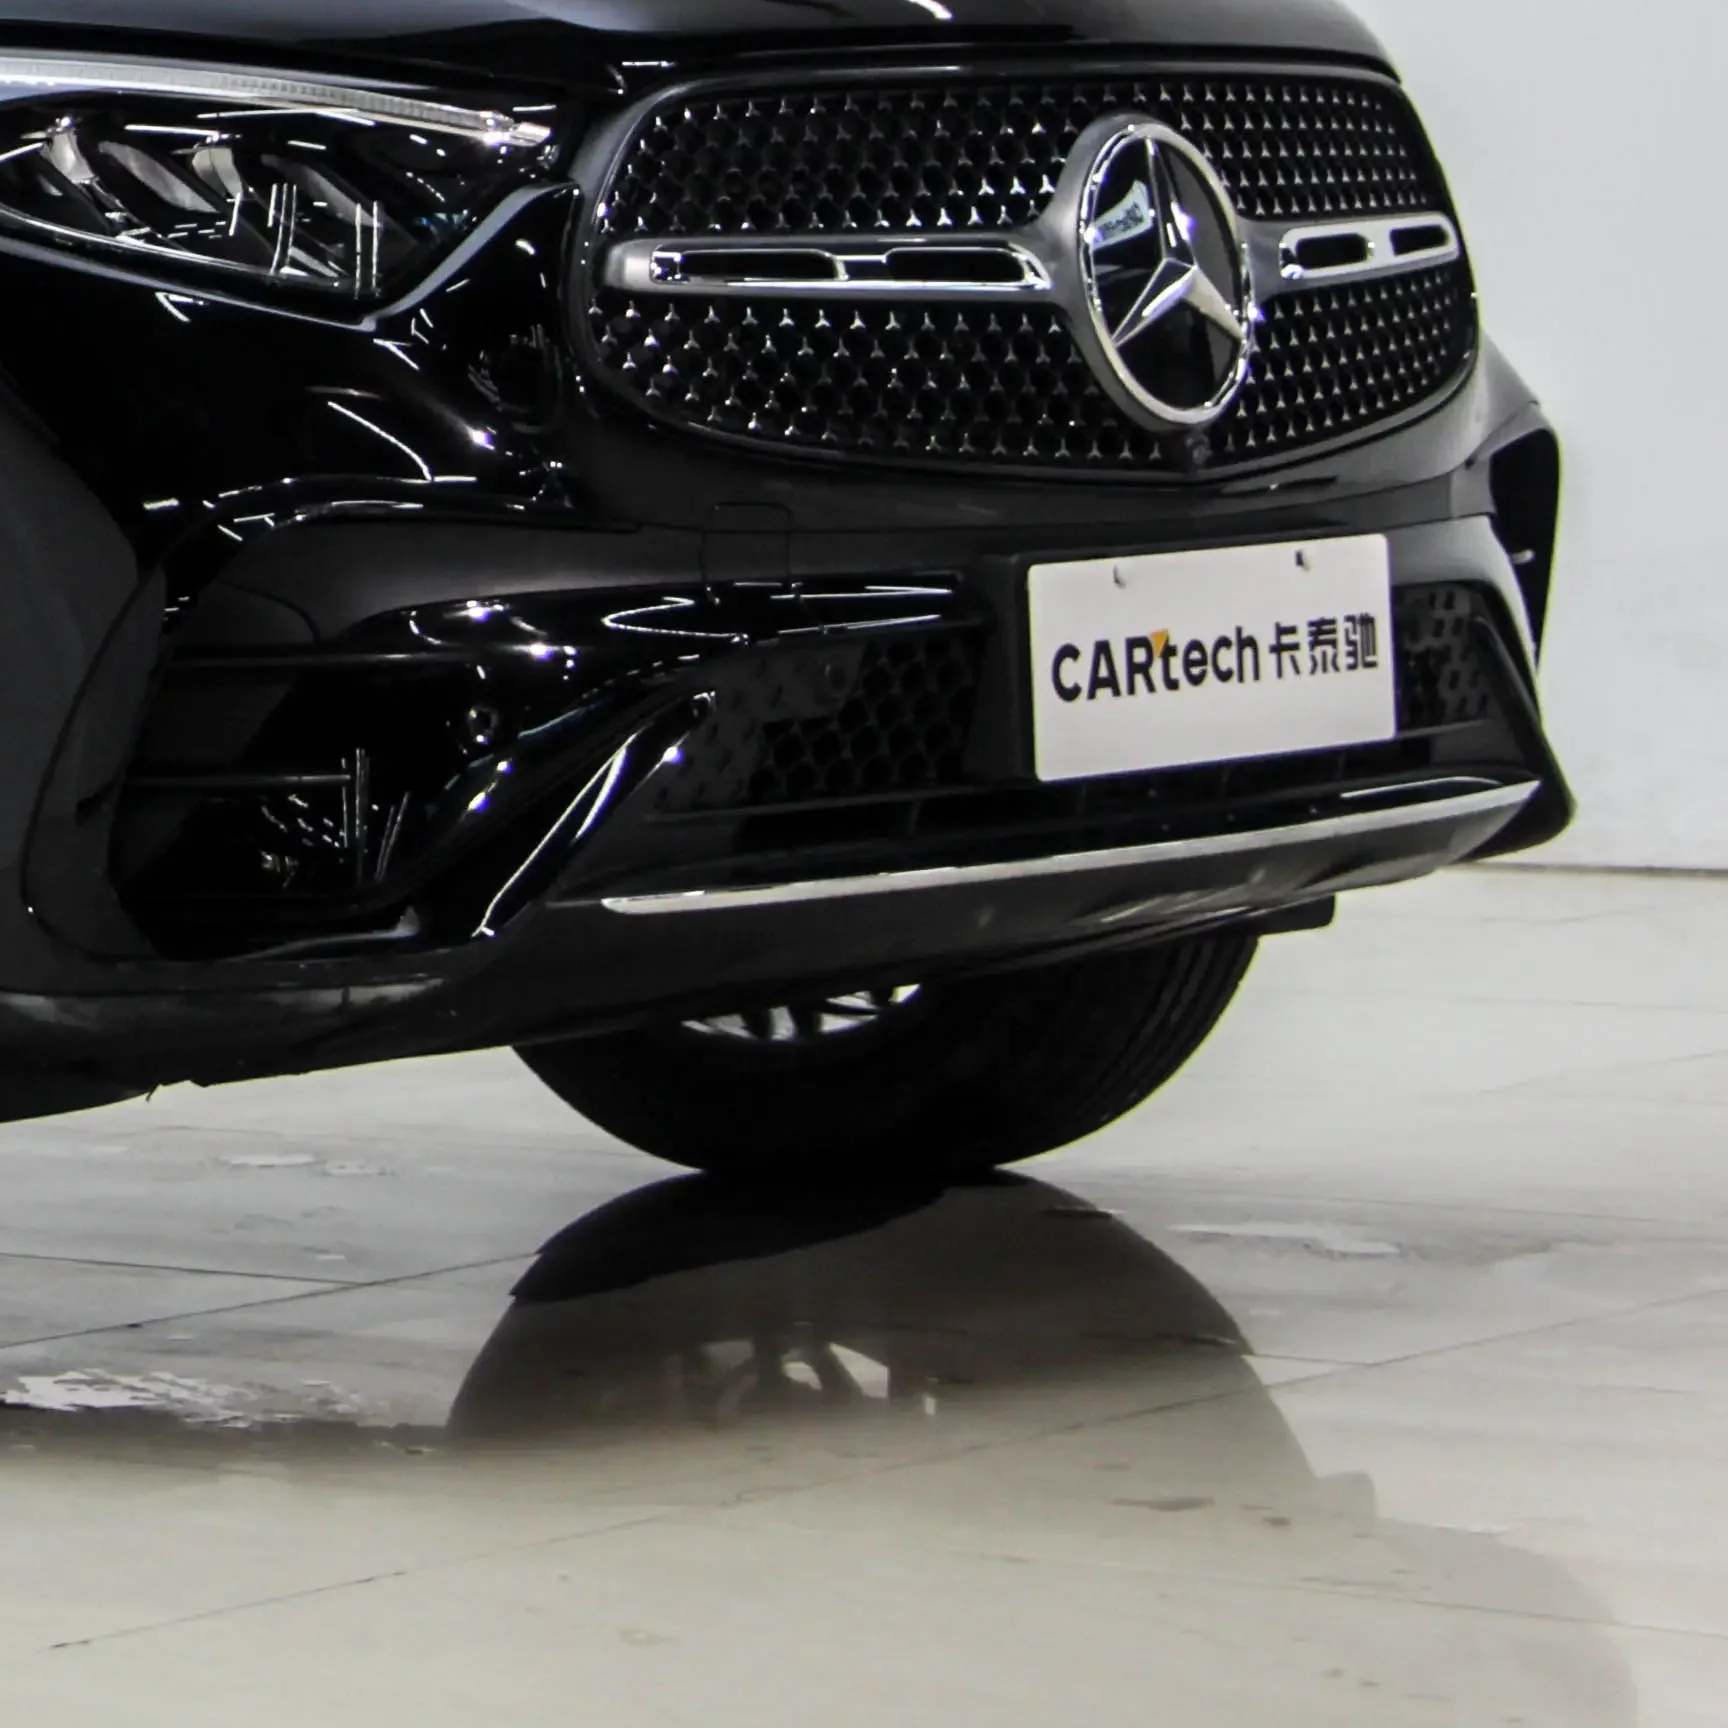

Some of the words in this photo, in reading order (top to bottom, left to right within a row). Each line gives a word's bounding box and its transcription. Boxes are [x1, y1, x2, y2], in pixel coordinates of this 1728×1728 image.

[1051, 626, 1260, 703] CARtech
[1269, 613, 1378, 679] 卡泰驰
